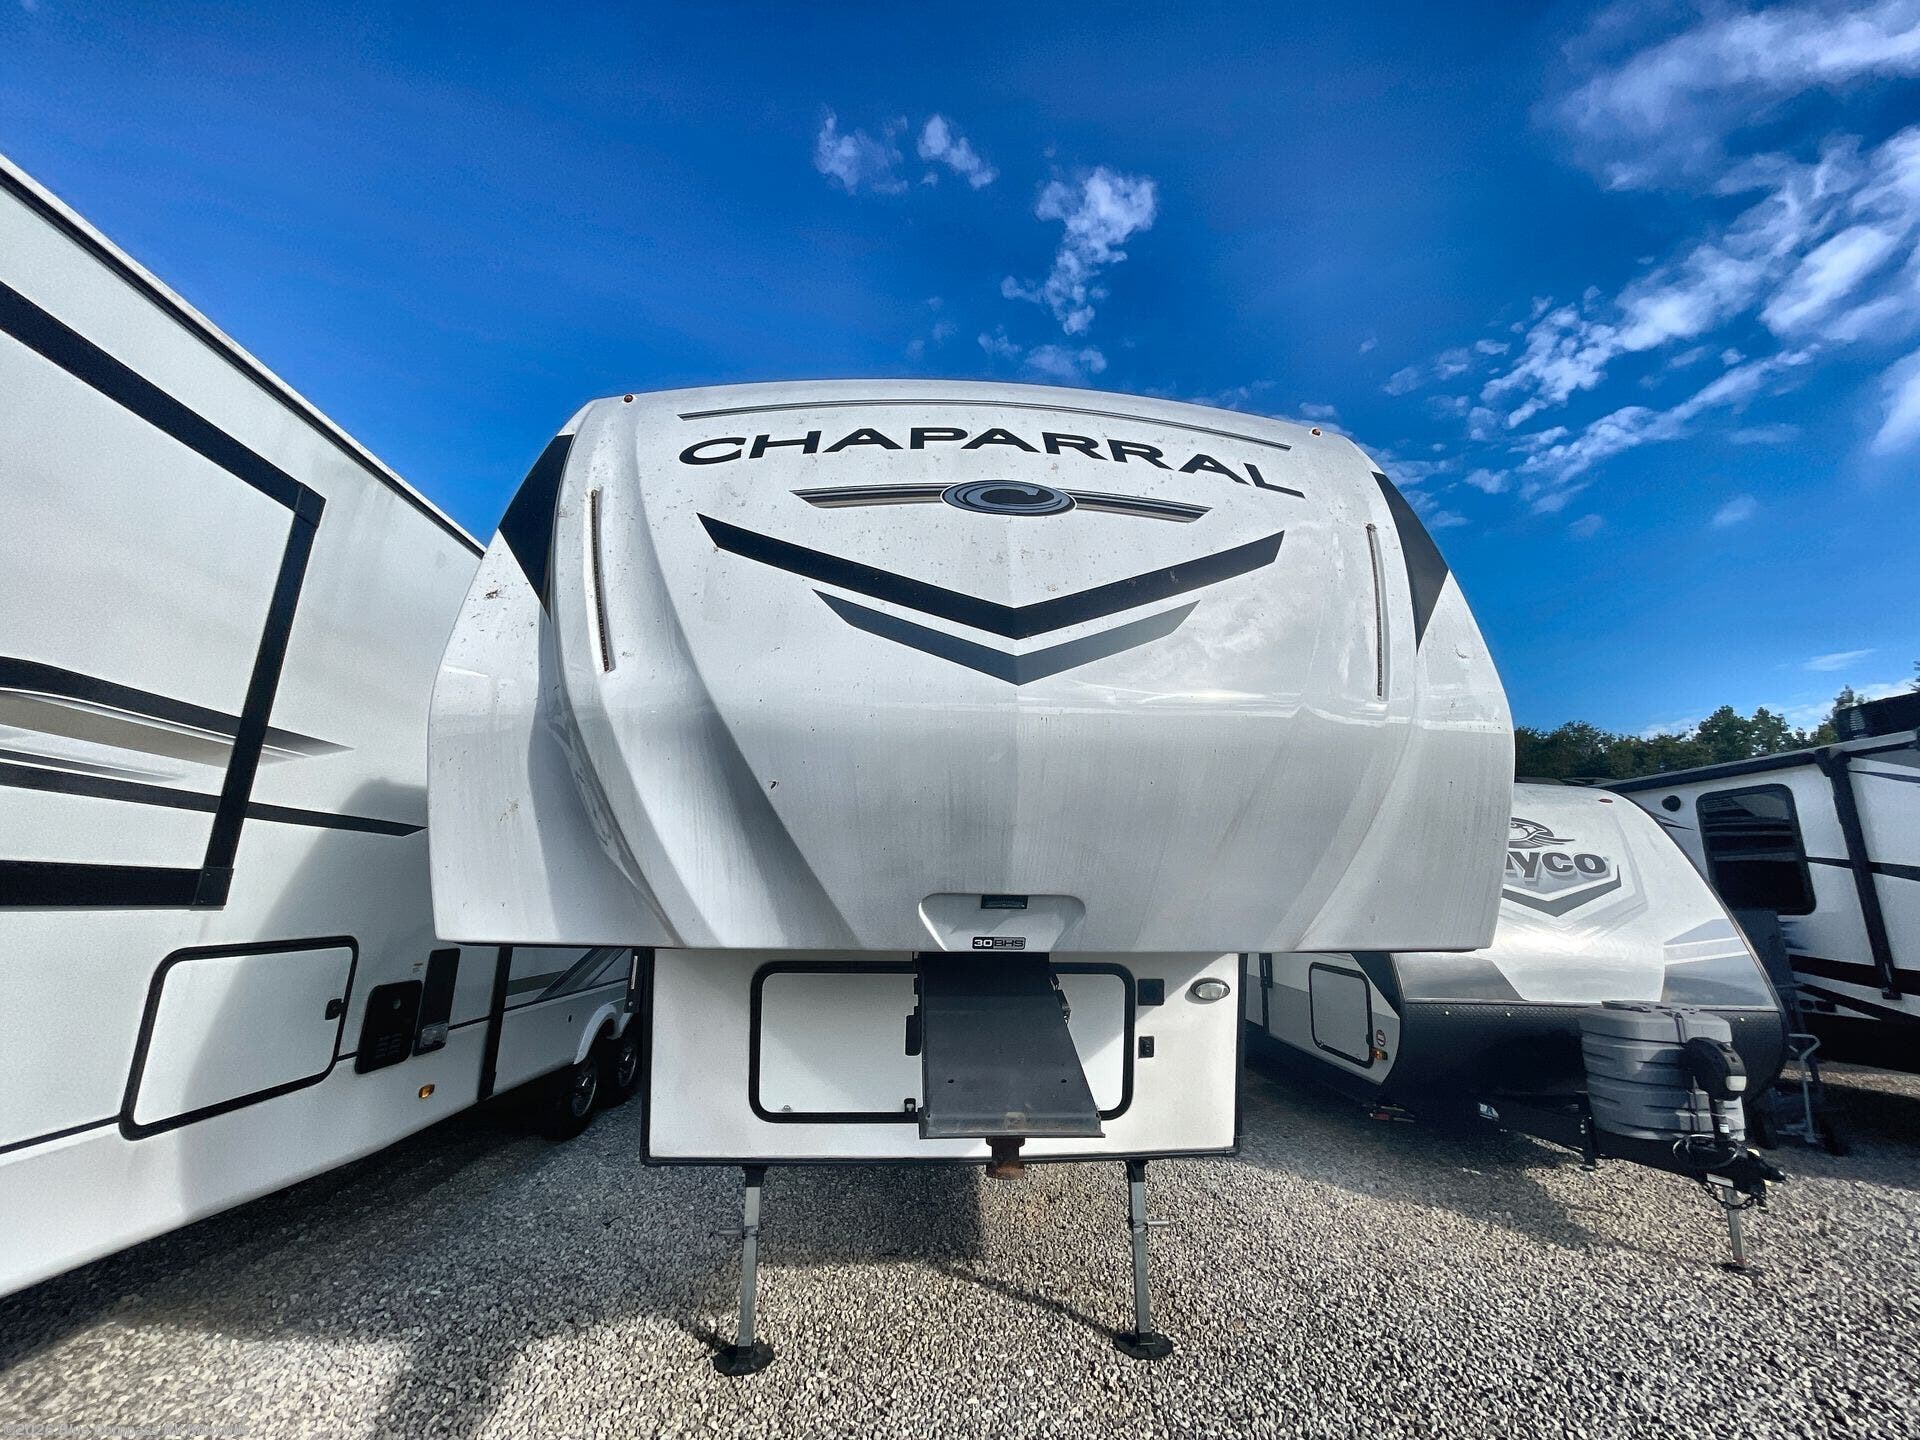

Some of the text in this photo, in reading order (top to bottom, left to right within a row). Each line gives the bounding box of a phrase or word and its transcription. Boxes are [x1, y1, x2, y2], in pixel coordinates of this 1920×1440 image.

[678, 427, 1306, 499] CHAPARRAL
[1505, 851, 1607, 880] YCO
[974, 939, 1024, 948] 30BHS
